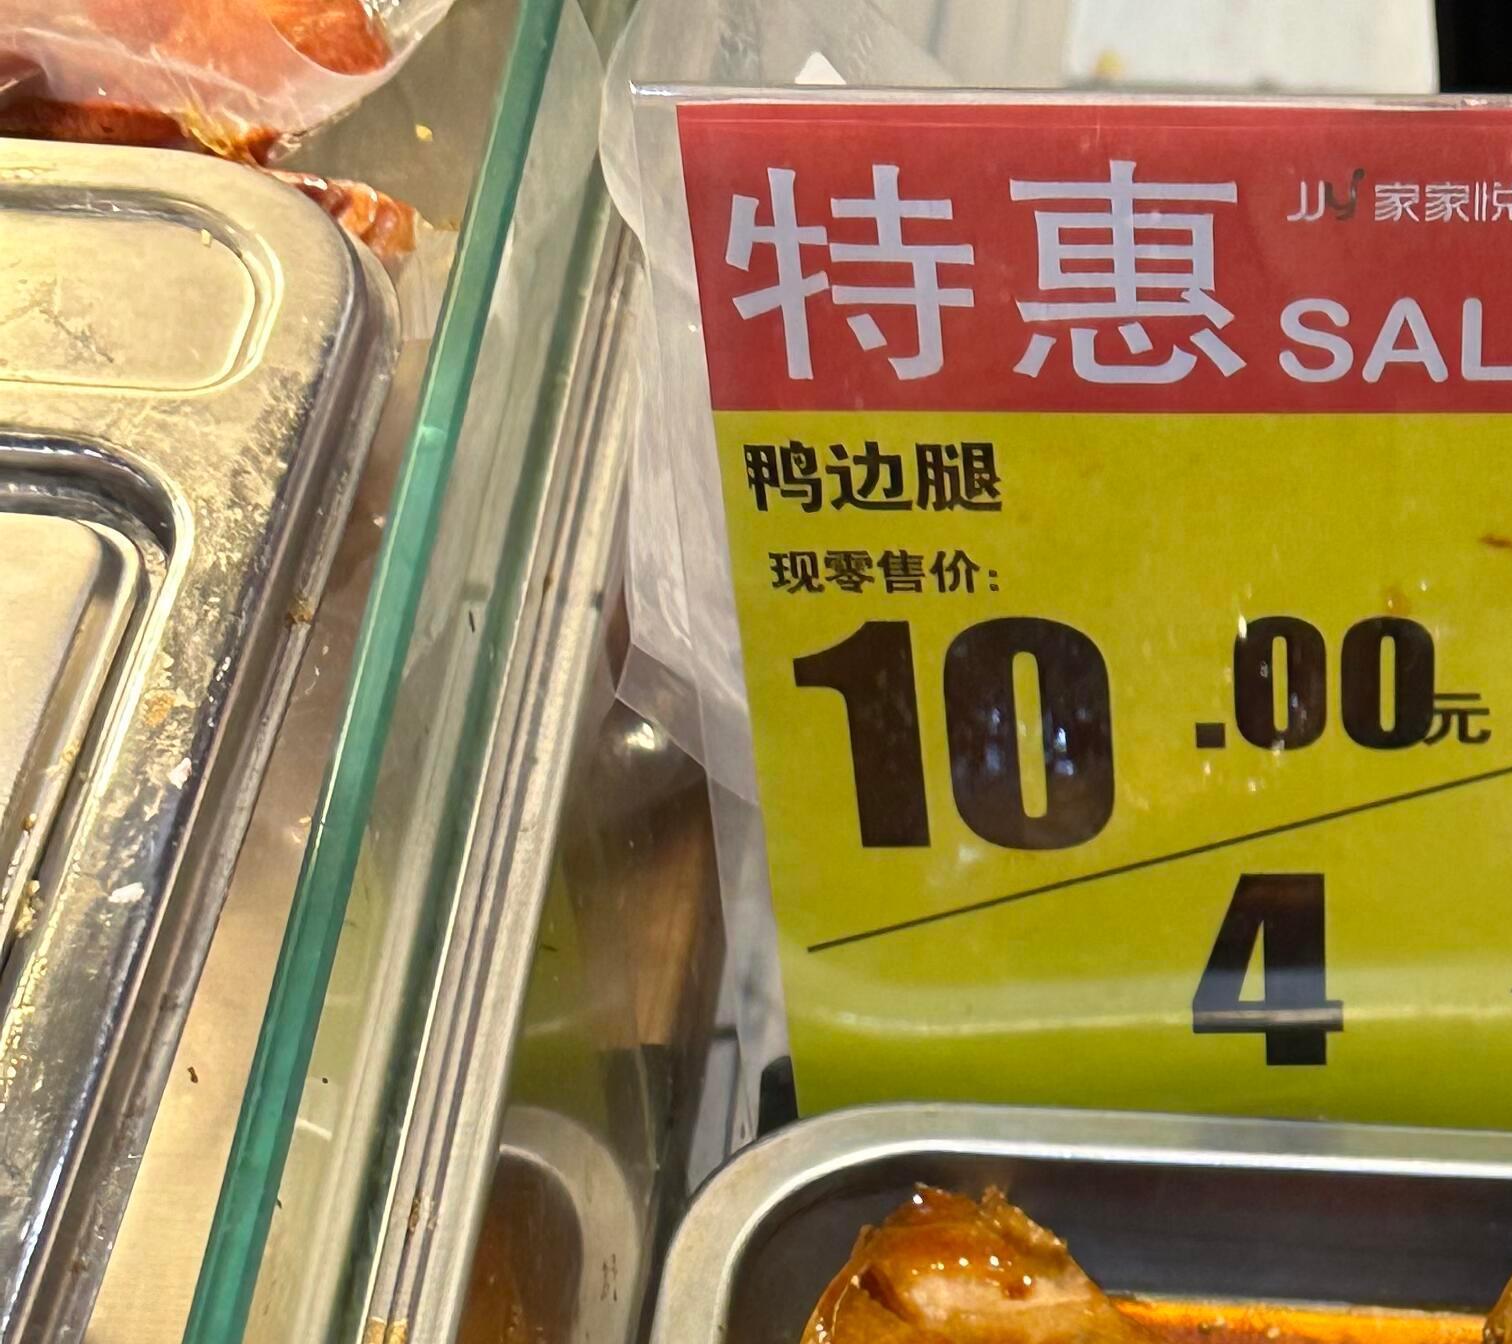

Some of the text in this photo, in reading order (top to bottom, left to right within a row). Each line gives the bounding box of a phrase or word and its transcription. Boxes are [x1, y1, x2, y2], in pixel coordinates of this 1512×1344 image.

[724, 161, 1245, 383] 特惠
[744, 440, 1002, 513] 鸭边腿
[1192, 873, 1344, 1066] 4
